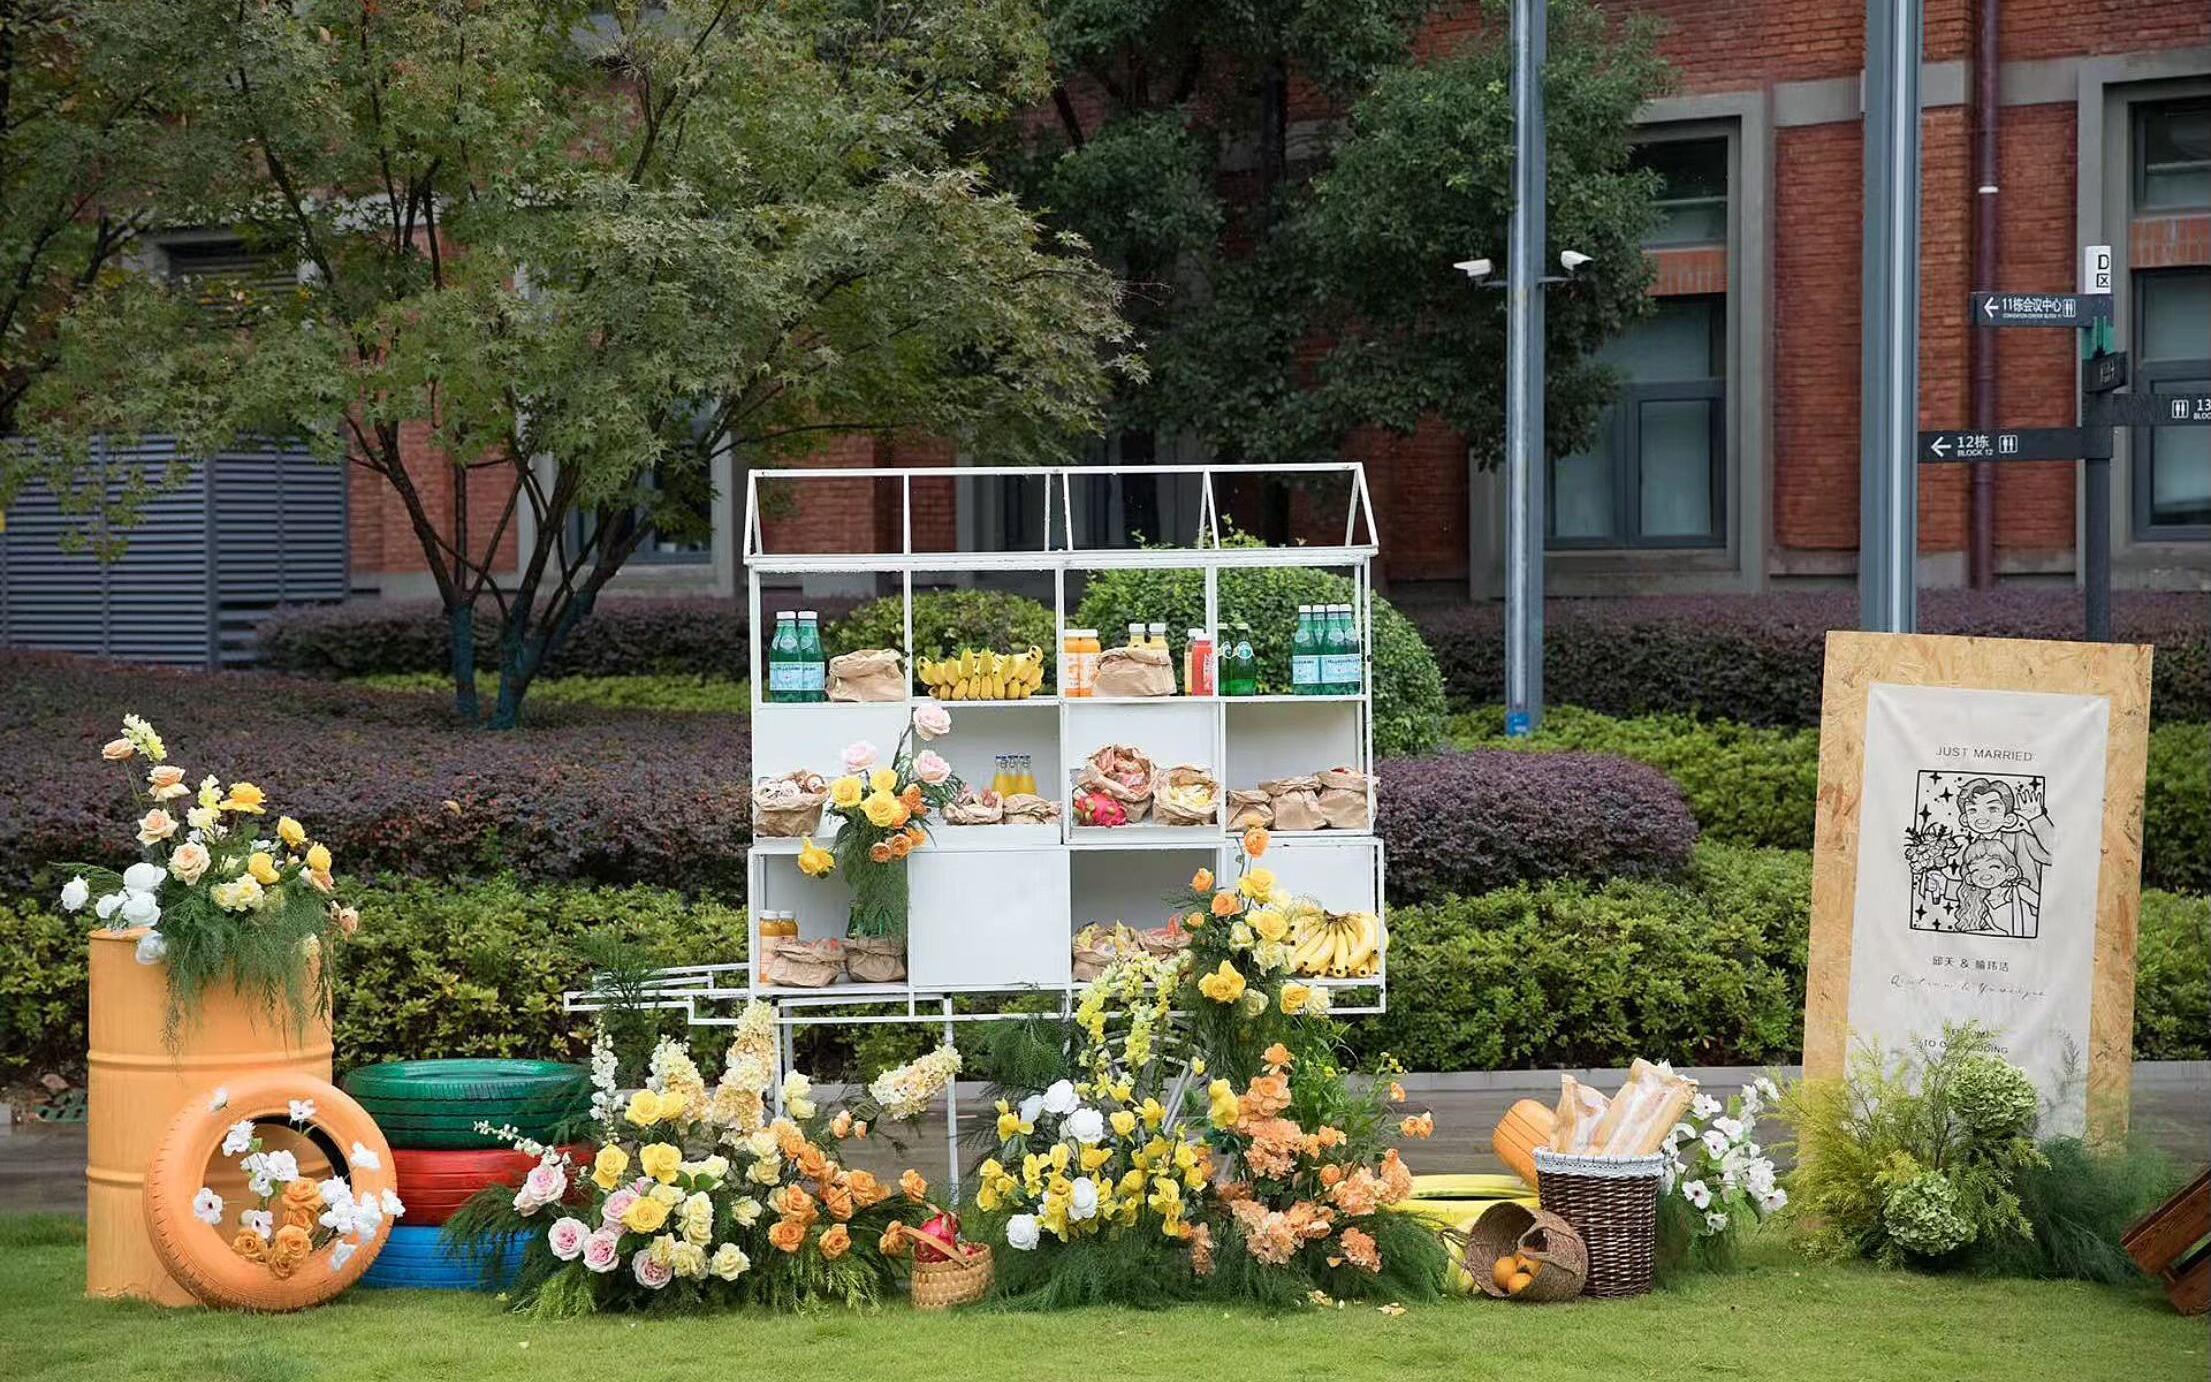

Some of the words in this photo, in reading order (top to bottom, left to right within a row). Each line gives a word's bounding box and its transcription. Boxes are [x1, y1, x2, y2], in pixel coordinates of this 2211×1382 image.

[2002, 297, 2062, 313] 11栋会议中心
[1957, 434, 1990, 450] 12栋
[1957, 449, 1983, 458] BLOCK
[1984, 449, 1994, 457] 12
[1936, 747, 1968, 757] JUST
[1973, 748, 2033, 761] MARRIED
[1960, 958, 1969, 969] &
